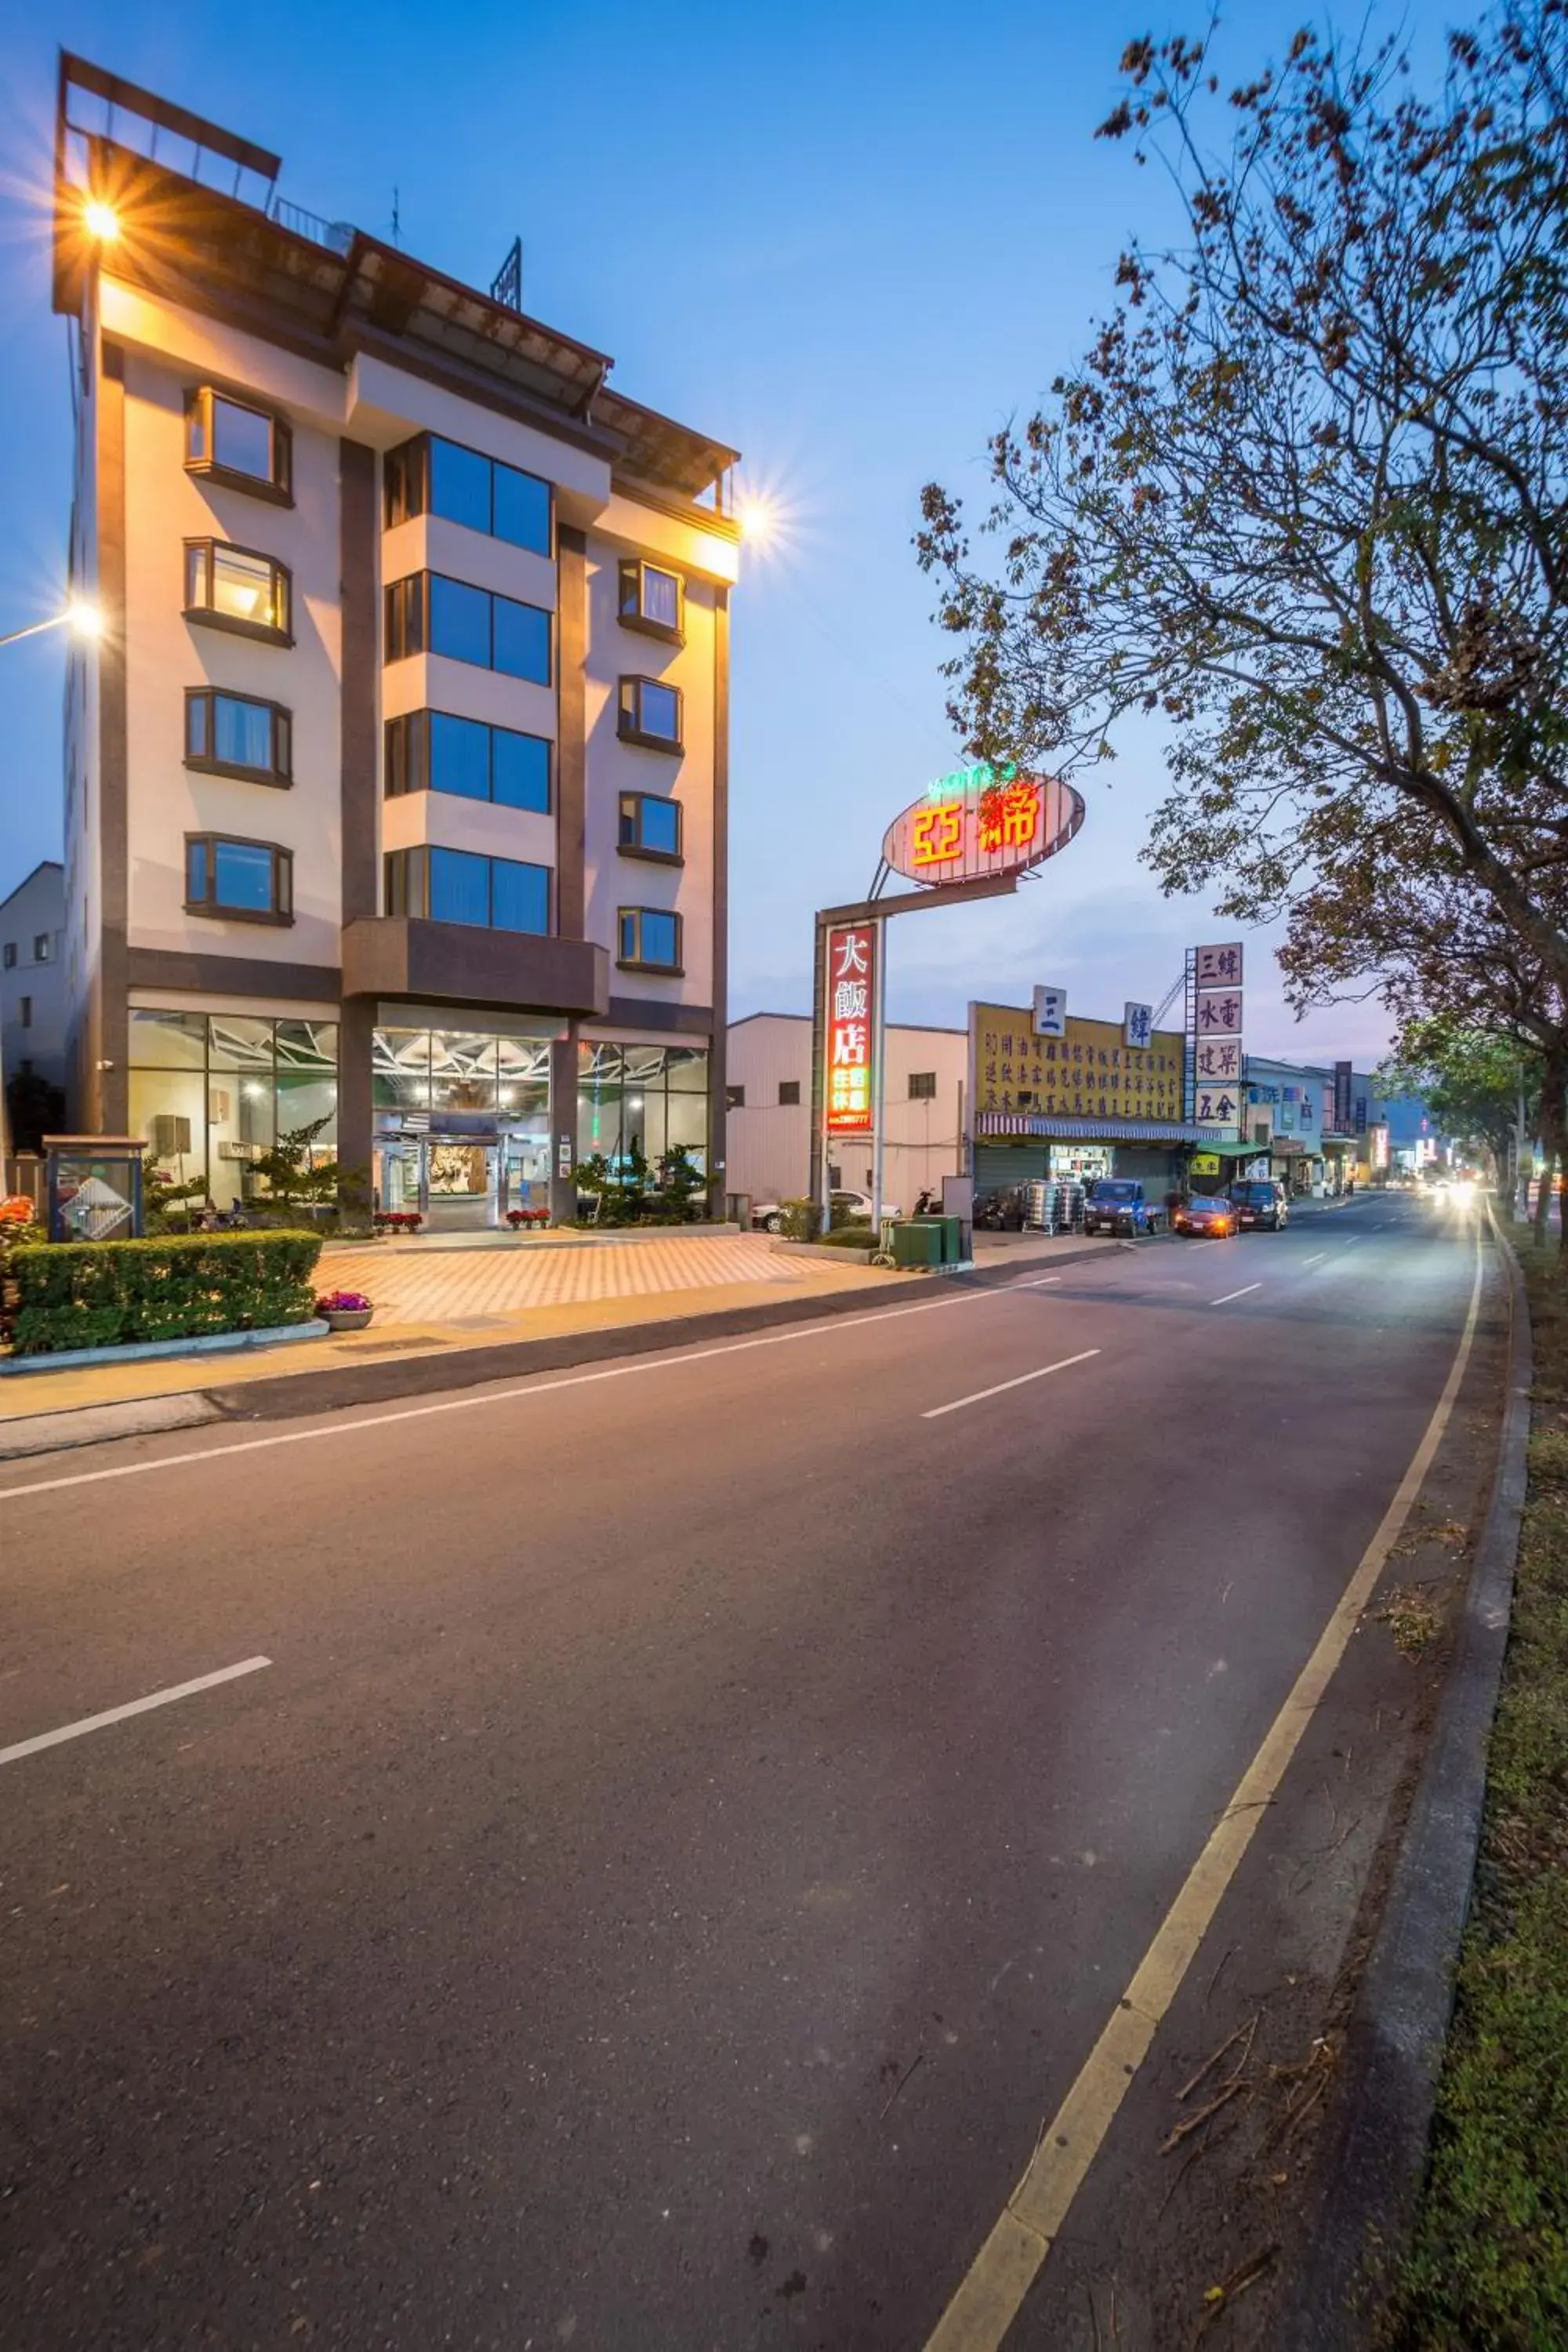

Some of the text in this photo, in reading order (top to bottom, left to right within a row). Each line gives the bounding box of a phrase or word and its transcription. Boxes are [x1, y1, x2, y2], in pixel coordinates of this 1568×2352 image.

[1200, 949, 1238, 979] 三緯
[834, 935, 868, 1065] 大飯店
[1200, 998, 1239, 1029] 水電
[1198, 1045, 1237, 1075] 建築
[1198, 1094, 1236, 1121] 五金
